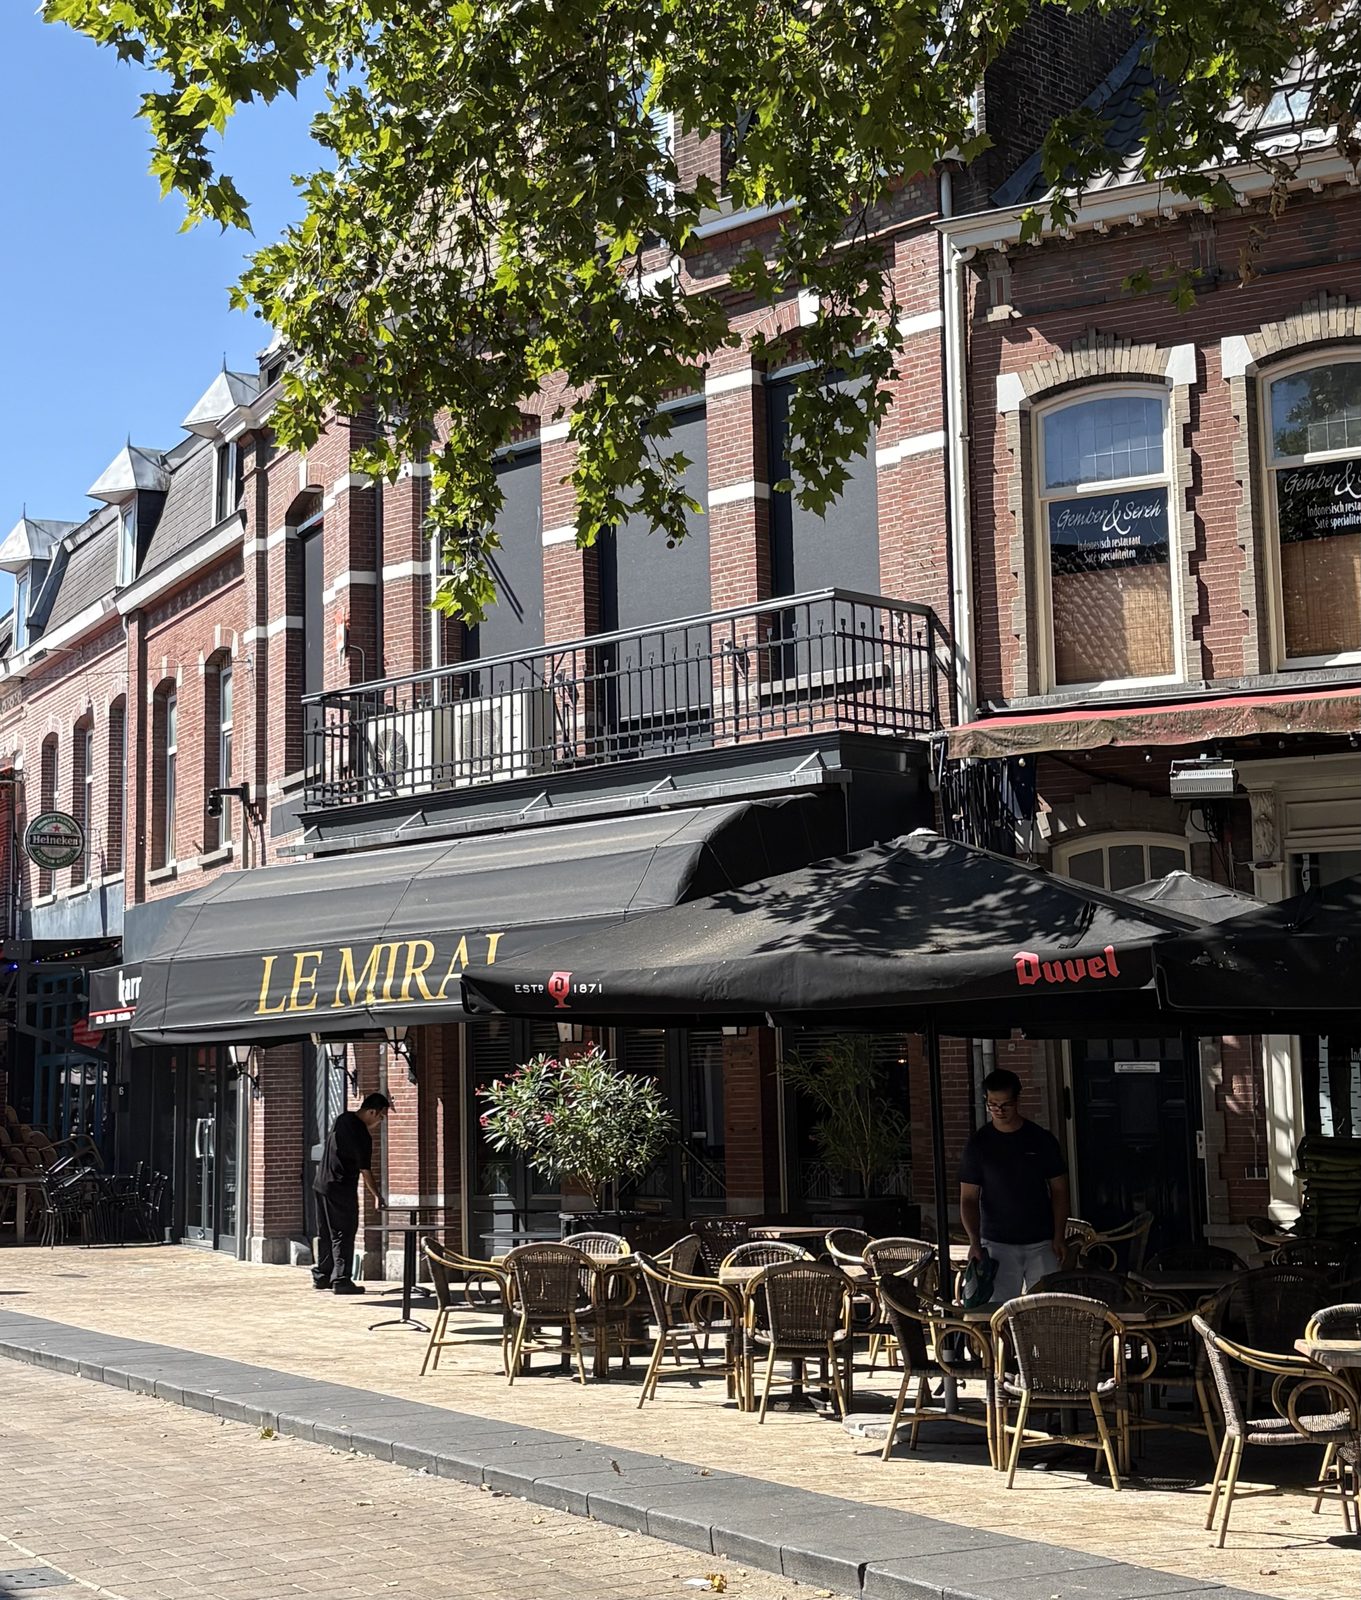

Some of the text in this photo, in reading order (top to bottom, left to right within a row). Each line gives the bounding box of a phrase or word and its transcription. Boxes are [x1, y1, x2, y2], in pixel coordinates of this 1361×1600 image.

[1284, 462, 1361, 499] Gember &
[1057, 500, 1162, 535] Gember & Sereh
[1111, 535, 1141, 549] restaurant
[32, 835, 79, 846] Heineken
[1012, 944, 1121, 985] Duvel
[254, 949, 324, 1015] LE
[573, 983, 602, 994] 1871
[119, 1086, 125, 1096] 6
